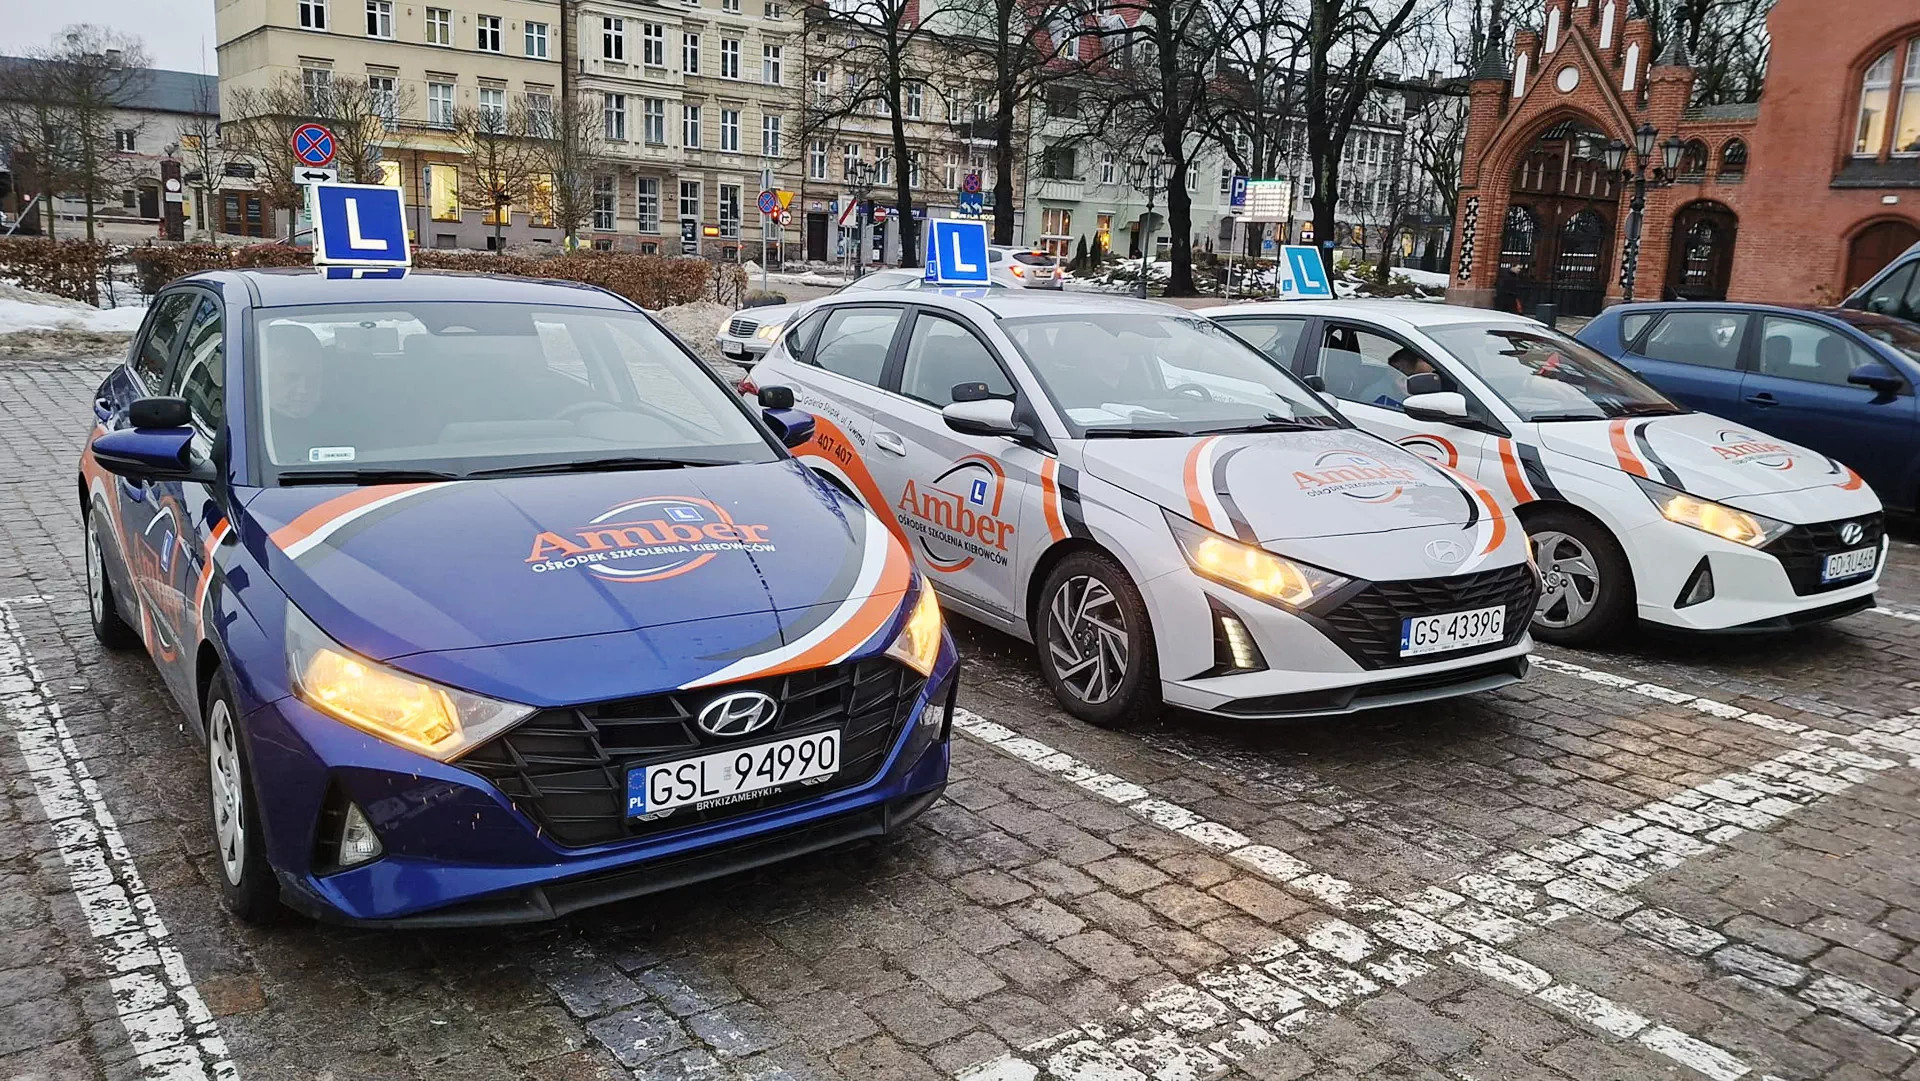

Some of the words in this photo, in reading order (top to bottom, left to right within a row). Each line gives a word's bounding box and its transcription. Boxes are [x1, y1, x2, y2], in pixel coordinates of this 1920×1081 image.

[1234, 178, 1246, 197] P
[344, 197, 388, 251] L
[952, 231, 978, 273] L
[1297, 254, 1321, 288] L
[817, 433, 835, 451] 407
[835, 444, 853, 464] 407
[898, 478, 1015, 552] Amber
[524, 519, 769, 563] Amber
[532, 551, 606, 573] OŚRODEK
[610, 544, 689, 560] SZKOLENIA
[690, 541, 776, 553] KIEROWCÓW
[898, 513, 927, 534] OŚRODEK
[928, 526, 964, 550] SZKOLENIA
[963, 540, 1009, 567] KIEROWCÓW
[1829, 555, 1843, 577] GD
[1414, 618, 1440, 646] GS
[1447, 609, 1501, 641] 4339G
[650, 760, 719, 805] GSL
[734, 735, 835, 790] 94990
[629, 796, 644, 808] PL
[696, 786, 782, 811] BRYKIZAMERYKI.PL
